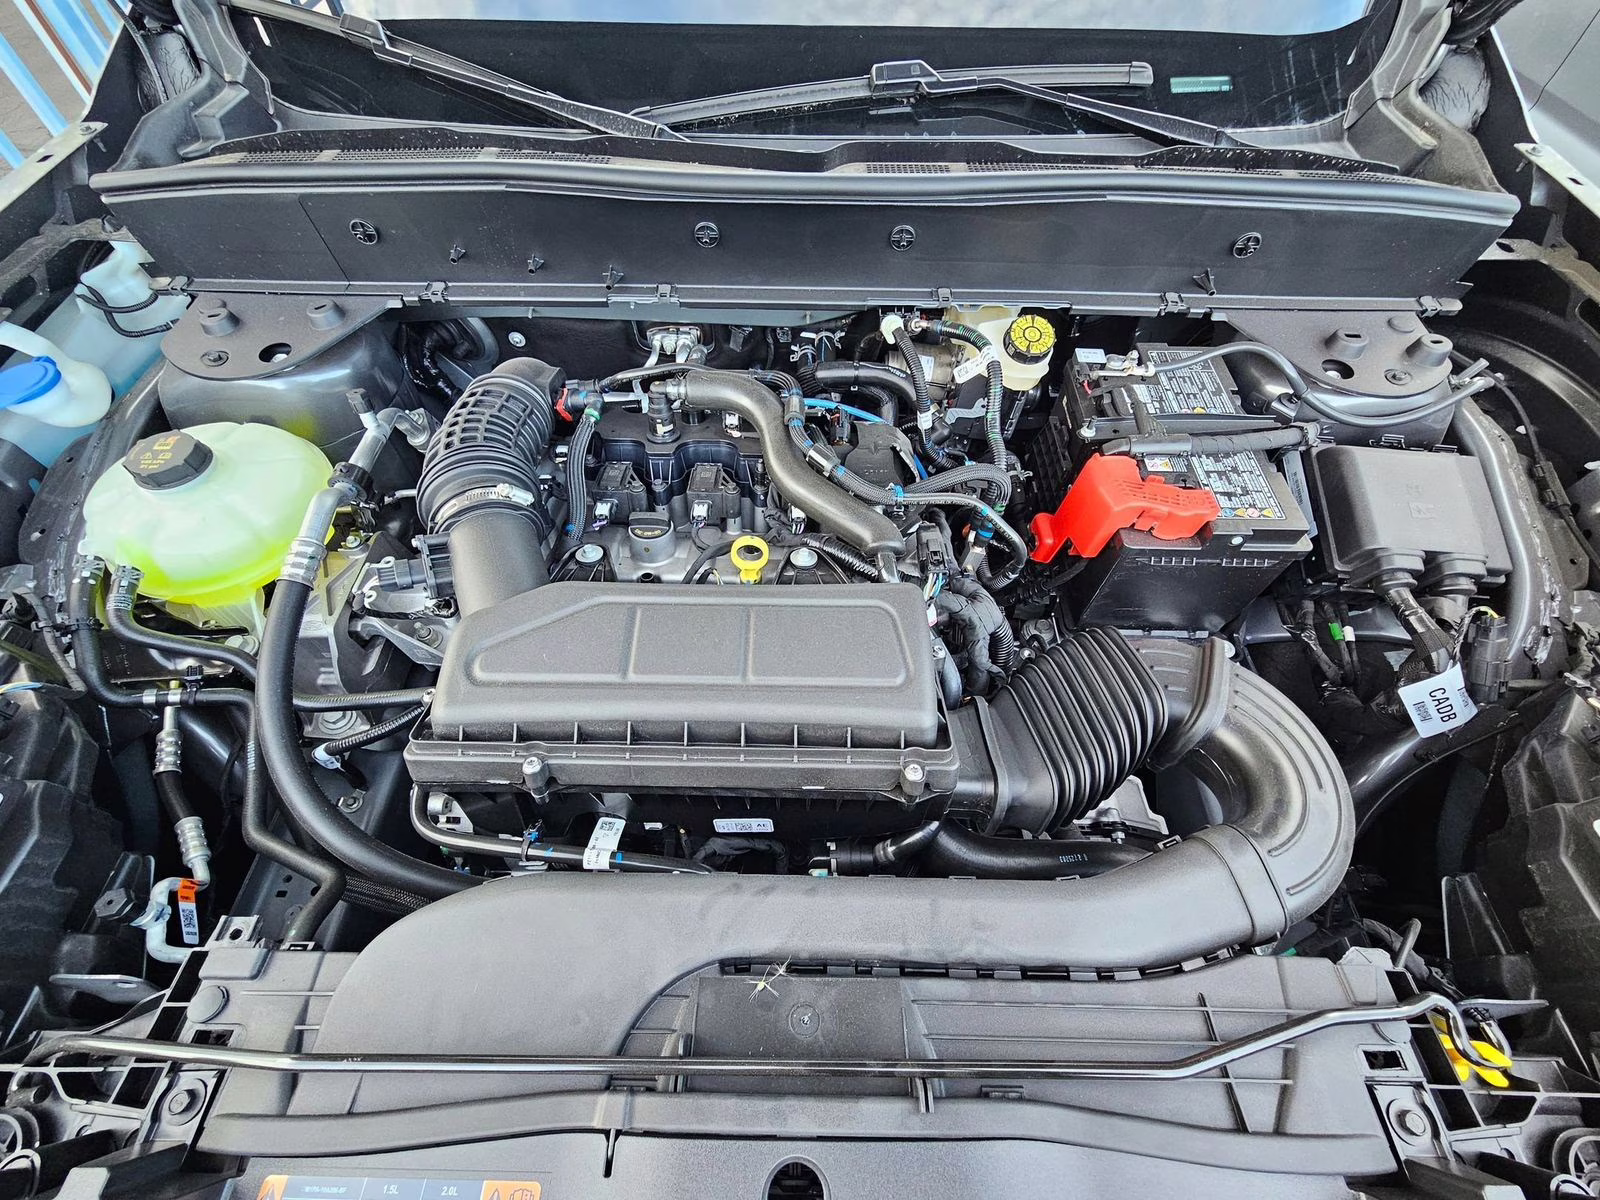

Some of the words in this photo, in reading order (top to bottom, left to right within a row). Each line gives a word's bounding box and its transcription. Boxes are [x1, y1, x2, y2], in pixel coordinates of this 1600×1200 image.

[1429, 687, 1457, 723] CADB
[383, 1184, 399, 1195] 1.5L
[441, 1186, 459, 1196] 2.0L
